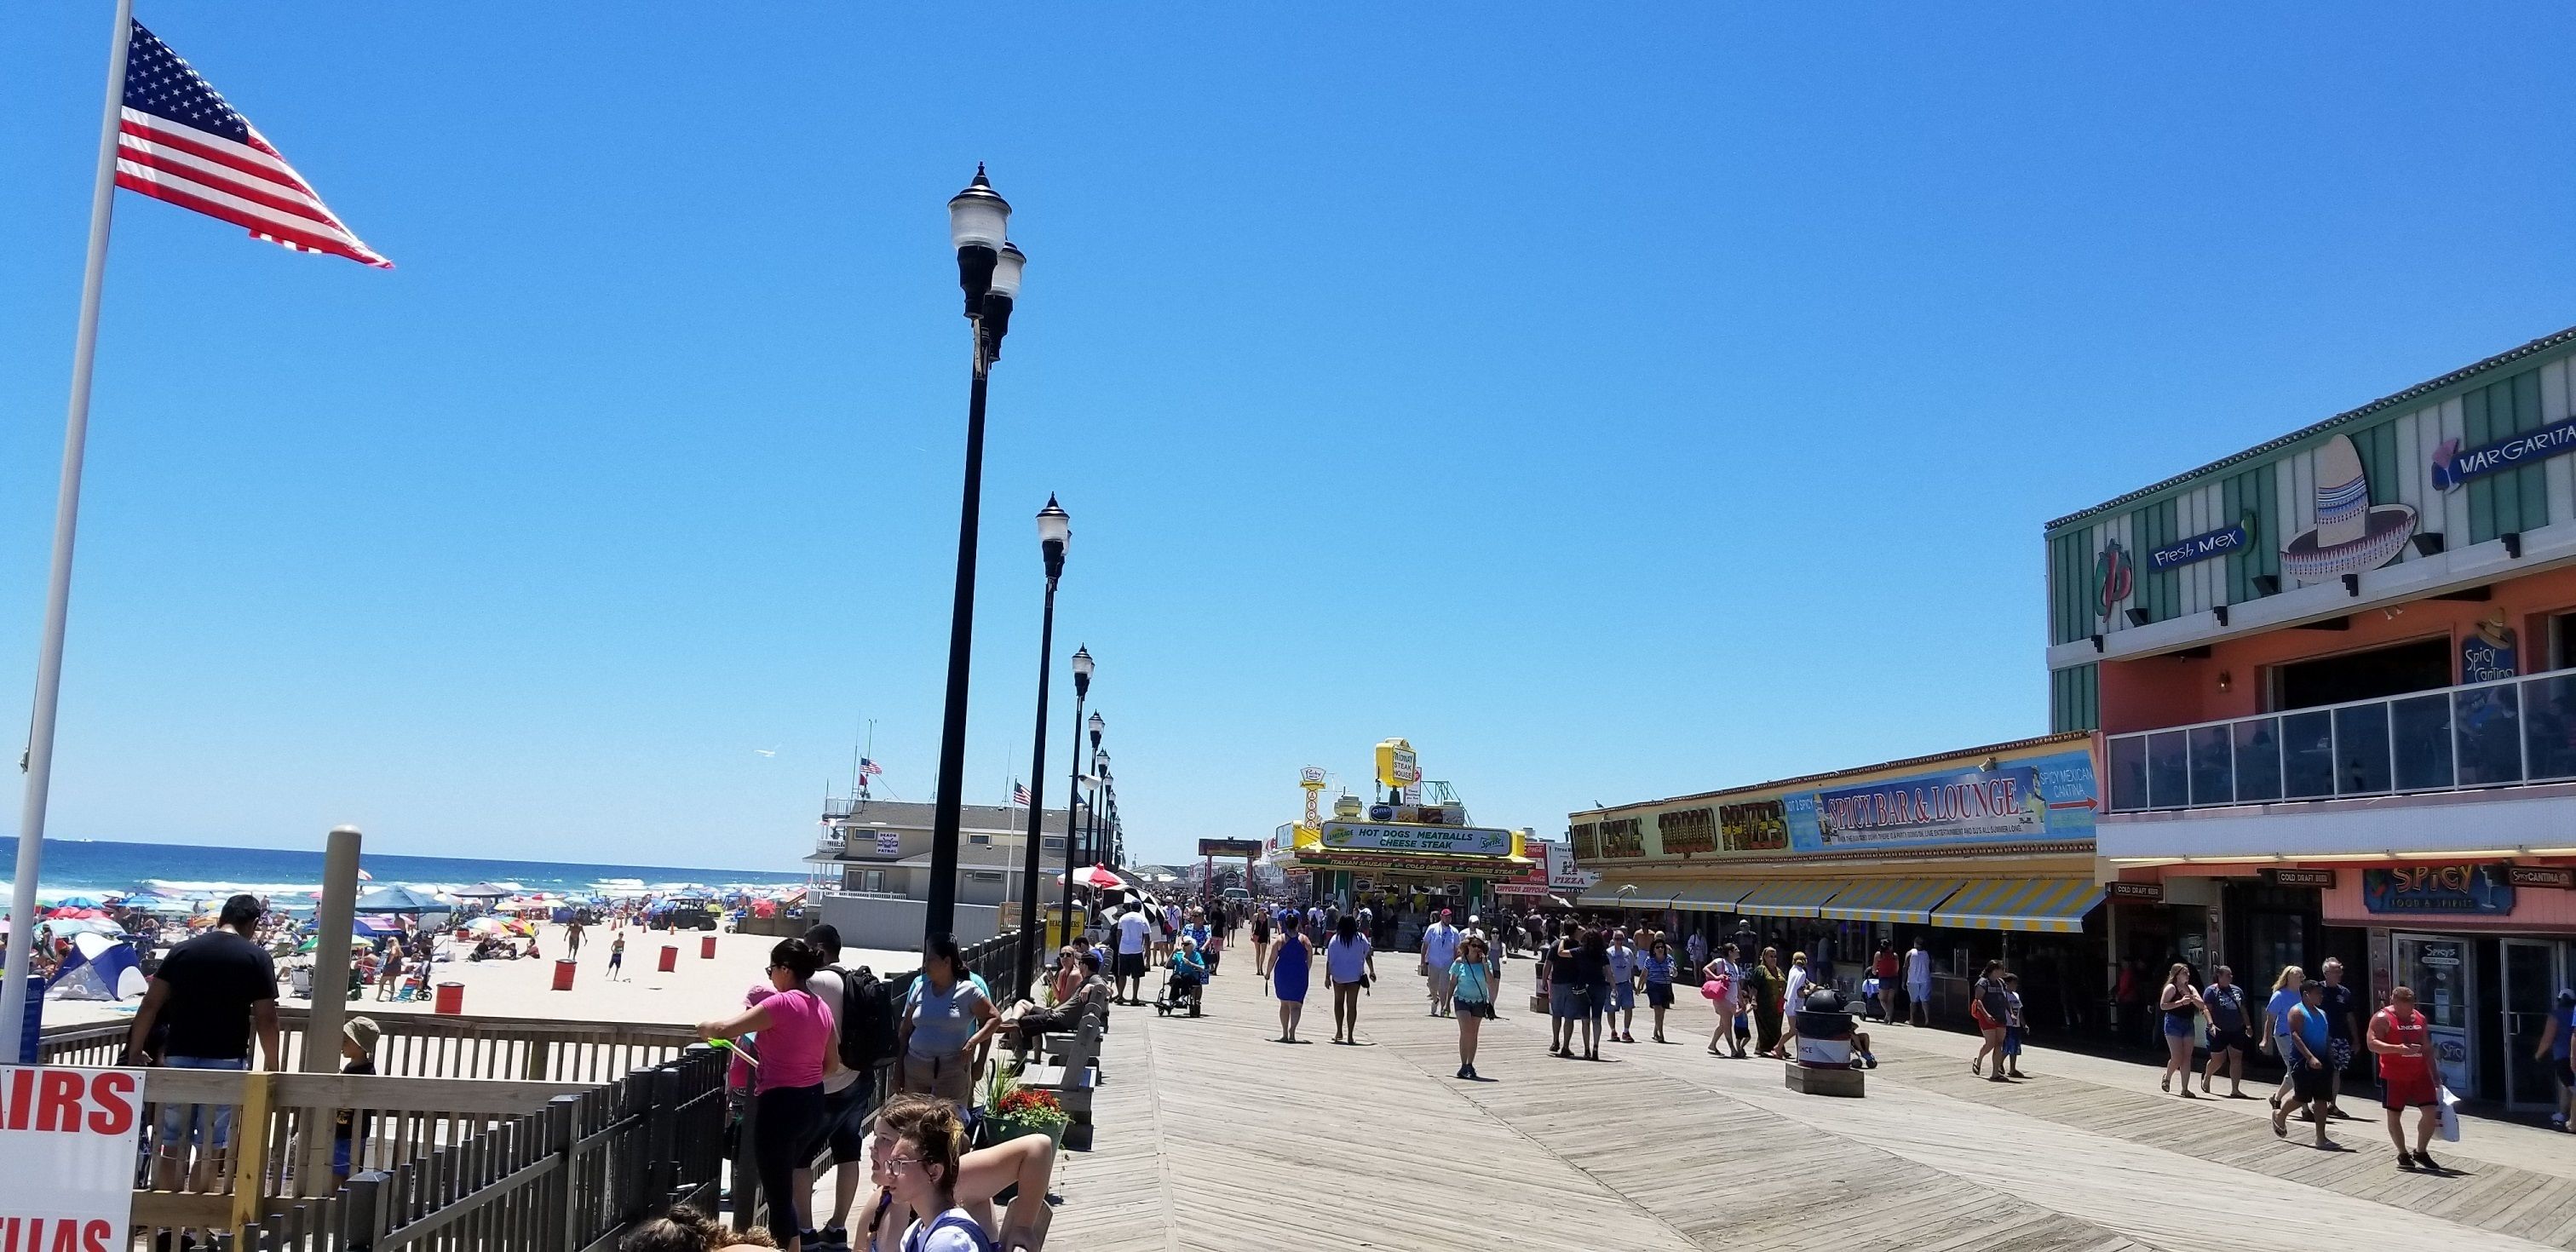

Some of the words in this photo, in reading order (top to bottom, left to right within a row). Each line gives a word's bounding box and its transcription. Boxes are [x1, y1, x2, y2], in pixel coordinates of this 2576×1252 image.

[2460, 425, 2576, 474] MARGARITA
[2154, 543, 2194, 566] Fresh
[2465, 647, 2495, 671] Spicy
[1394, 751, 1412, 763] MIDWAY
[1394, 761, 1412, 771] STEAK
[1394, 770, 1412, 779] HOUSE
[2039, 771, 2059, 784] SPICY
[2061, 767, 2093, 783] MEXICAN
[2054, 783, 2085, 798] CANTINA
[1828, 794, 1872, 832] SPICY
[1874, 790, 1912, 827] BAR
[1914, 787, 1931, 824] &
[1932, 777, 2020, 823] LOUNGE
[1358, 829, 1379, 837] HOT
[1383, 830, 1411, 838] DOGS
[1417, 831, 1474, 841] MEATBALLS
[1379, 839, 1417, 847] CHEESE
[1421, 841, 1453, 849] STEAK
[2391, 899, 2419, 908] FOOD
[0, 1068, 135, 1135] IRS
[0, 1216, 112, 1252] LLAS
